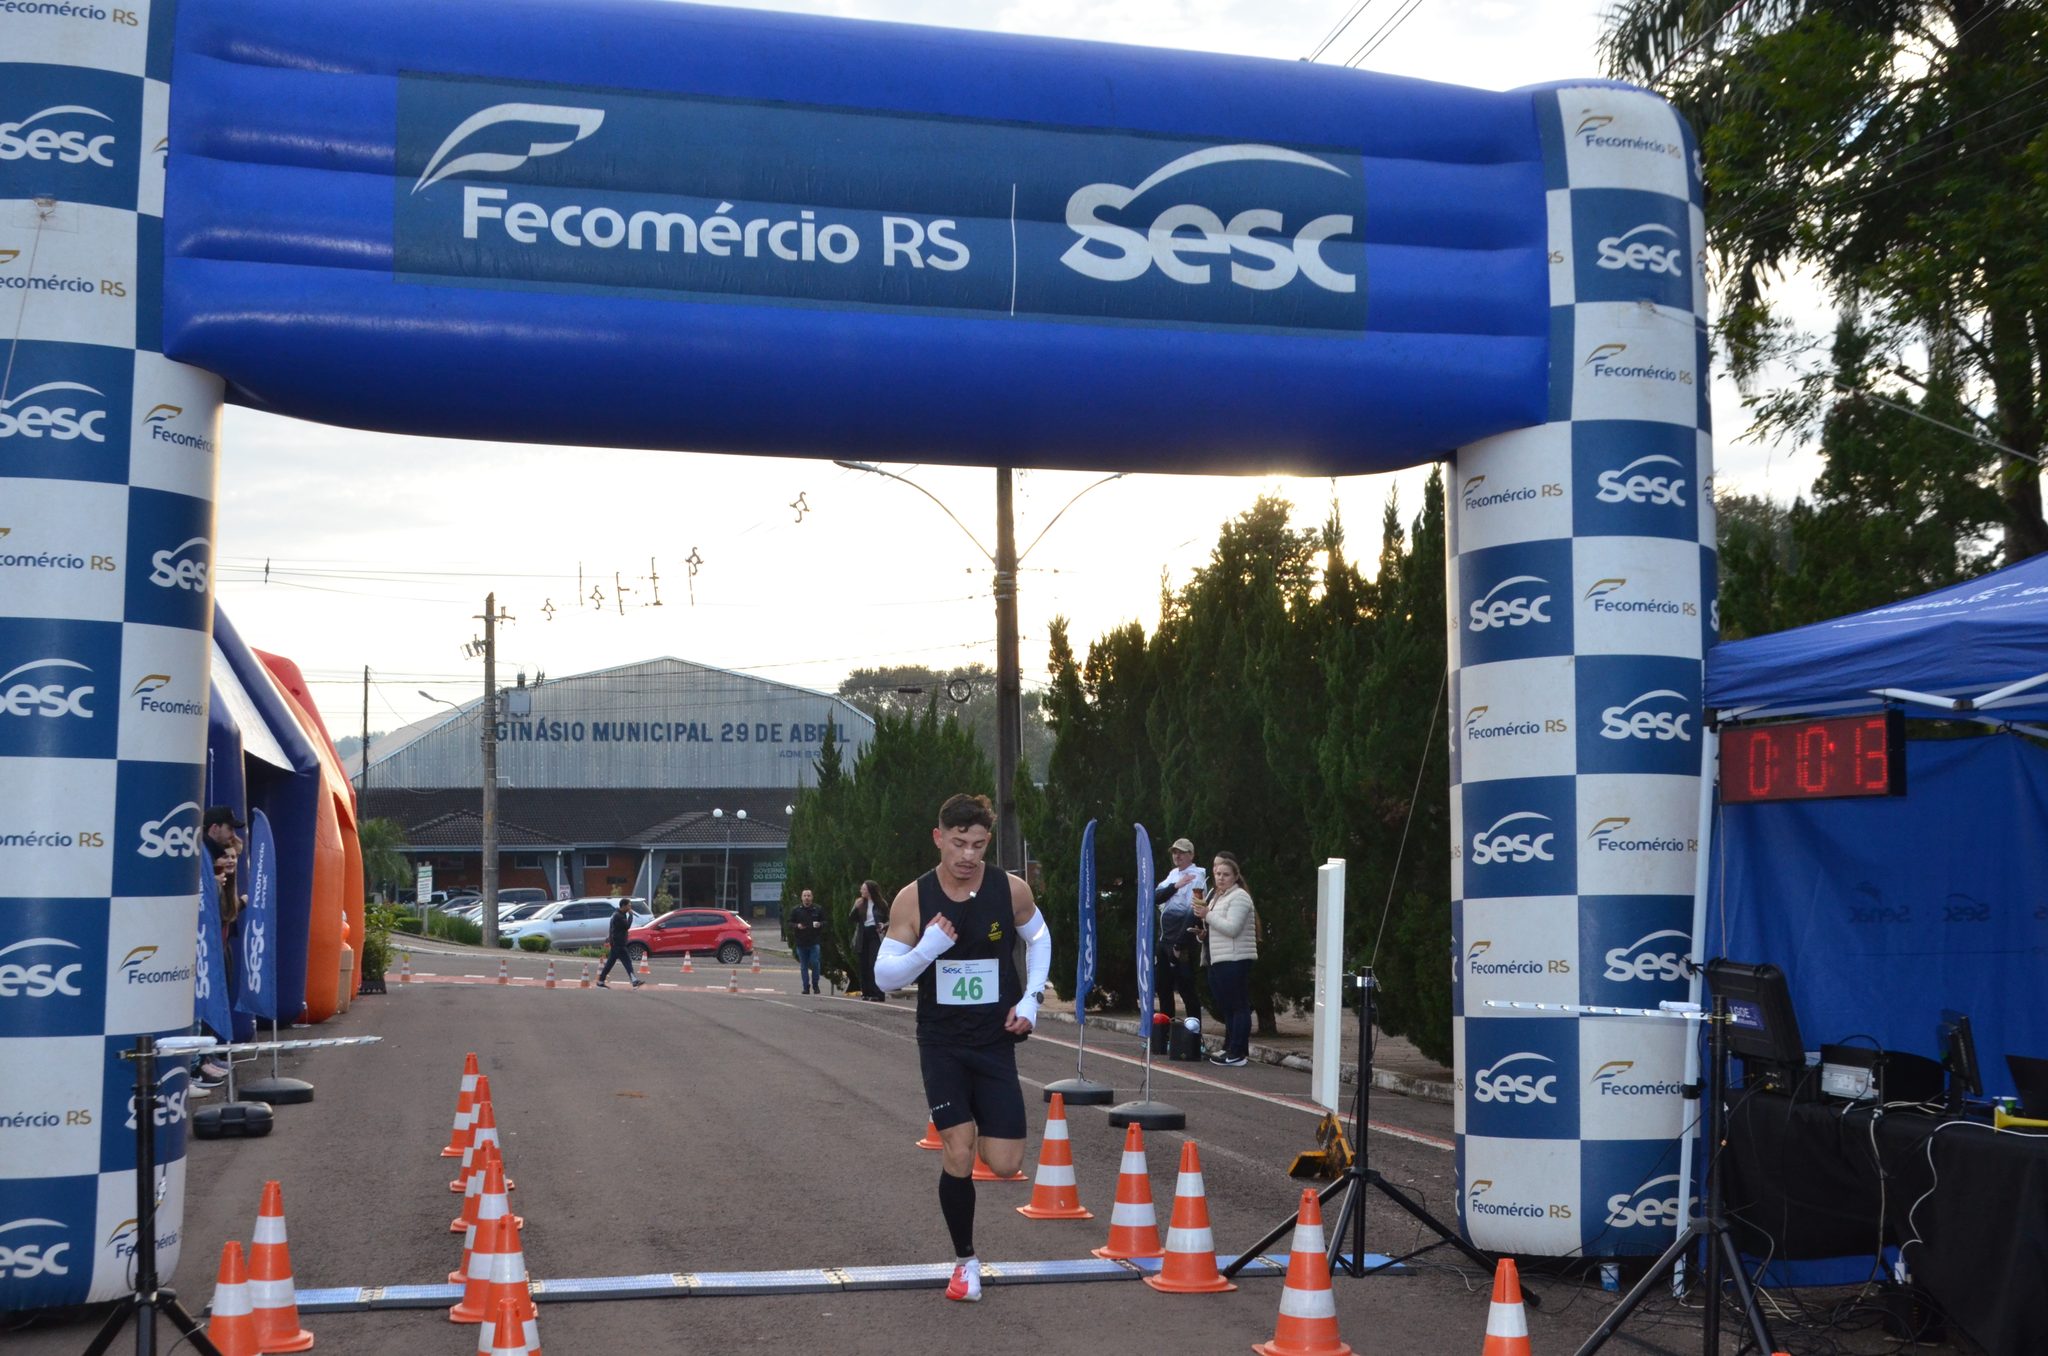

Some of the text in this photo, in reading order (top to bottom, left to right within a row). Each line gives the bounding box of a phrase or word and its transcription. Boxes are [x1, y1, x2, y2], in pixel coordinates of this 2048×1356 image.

[0, 0, 139, 27] ecomércio RS
[0, 105, 114, 167] Sesc
[1586, 134, 1682, 159] Fecomércio RS
[462, 184, 971, 272] Fecomércio RS
[1060, 144, 1357, 293] Sesc
[1596, 223, 1682, 277] Sesc
[101, 279, 126, 297] RS
[1594, 364, 1693, 385] Fecomércio RS
[1595, 454, 1686, 507] Sesc
[1465, 483, 1564, 510] Fecomércio RS
[90, 555, 116, 571] RS
[1469, 575, 1551, 632] Sesc
[1594, 598, 1680, 614] Fecomércio
[1682, 603, 1697, 617] RS
[0, 658, 94, 718] esc
[141, 696, 203, 716] Fecomércio
[1600, 689, 1691, 742] Sesc
[496, 717, 585, 742] GINÁSIO
[592, 722, 714, 742] MUNICIPAL
[721, 723, 749, 742] 29
[755, 724, 783, 742] DE
[1468, 719, 1568, 740] Fecomércio RS
[78, 832, 105, 848] RS
[1472, 811, 1554, 865] Sesc
[1597, 837, 1684, 852] Fecomércio
[0, 937, 82, 997] esc
[246, 920, 265, 995] Sesc
[942, 965, 962, 975] Sesc
[1471, 959, 1571, 975] Fecomércio RS
[128, 965, 190, 984] Fecomércio
[952, 976, 983, 1001] 46
[1474, 1052, 1557, 1104] Sesc
[66, 1110, 92, 1127] RS
[1472, 1199, 1572, 1219] Fecomércio RS
